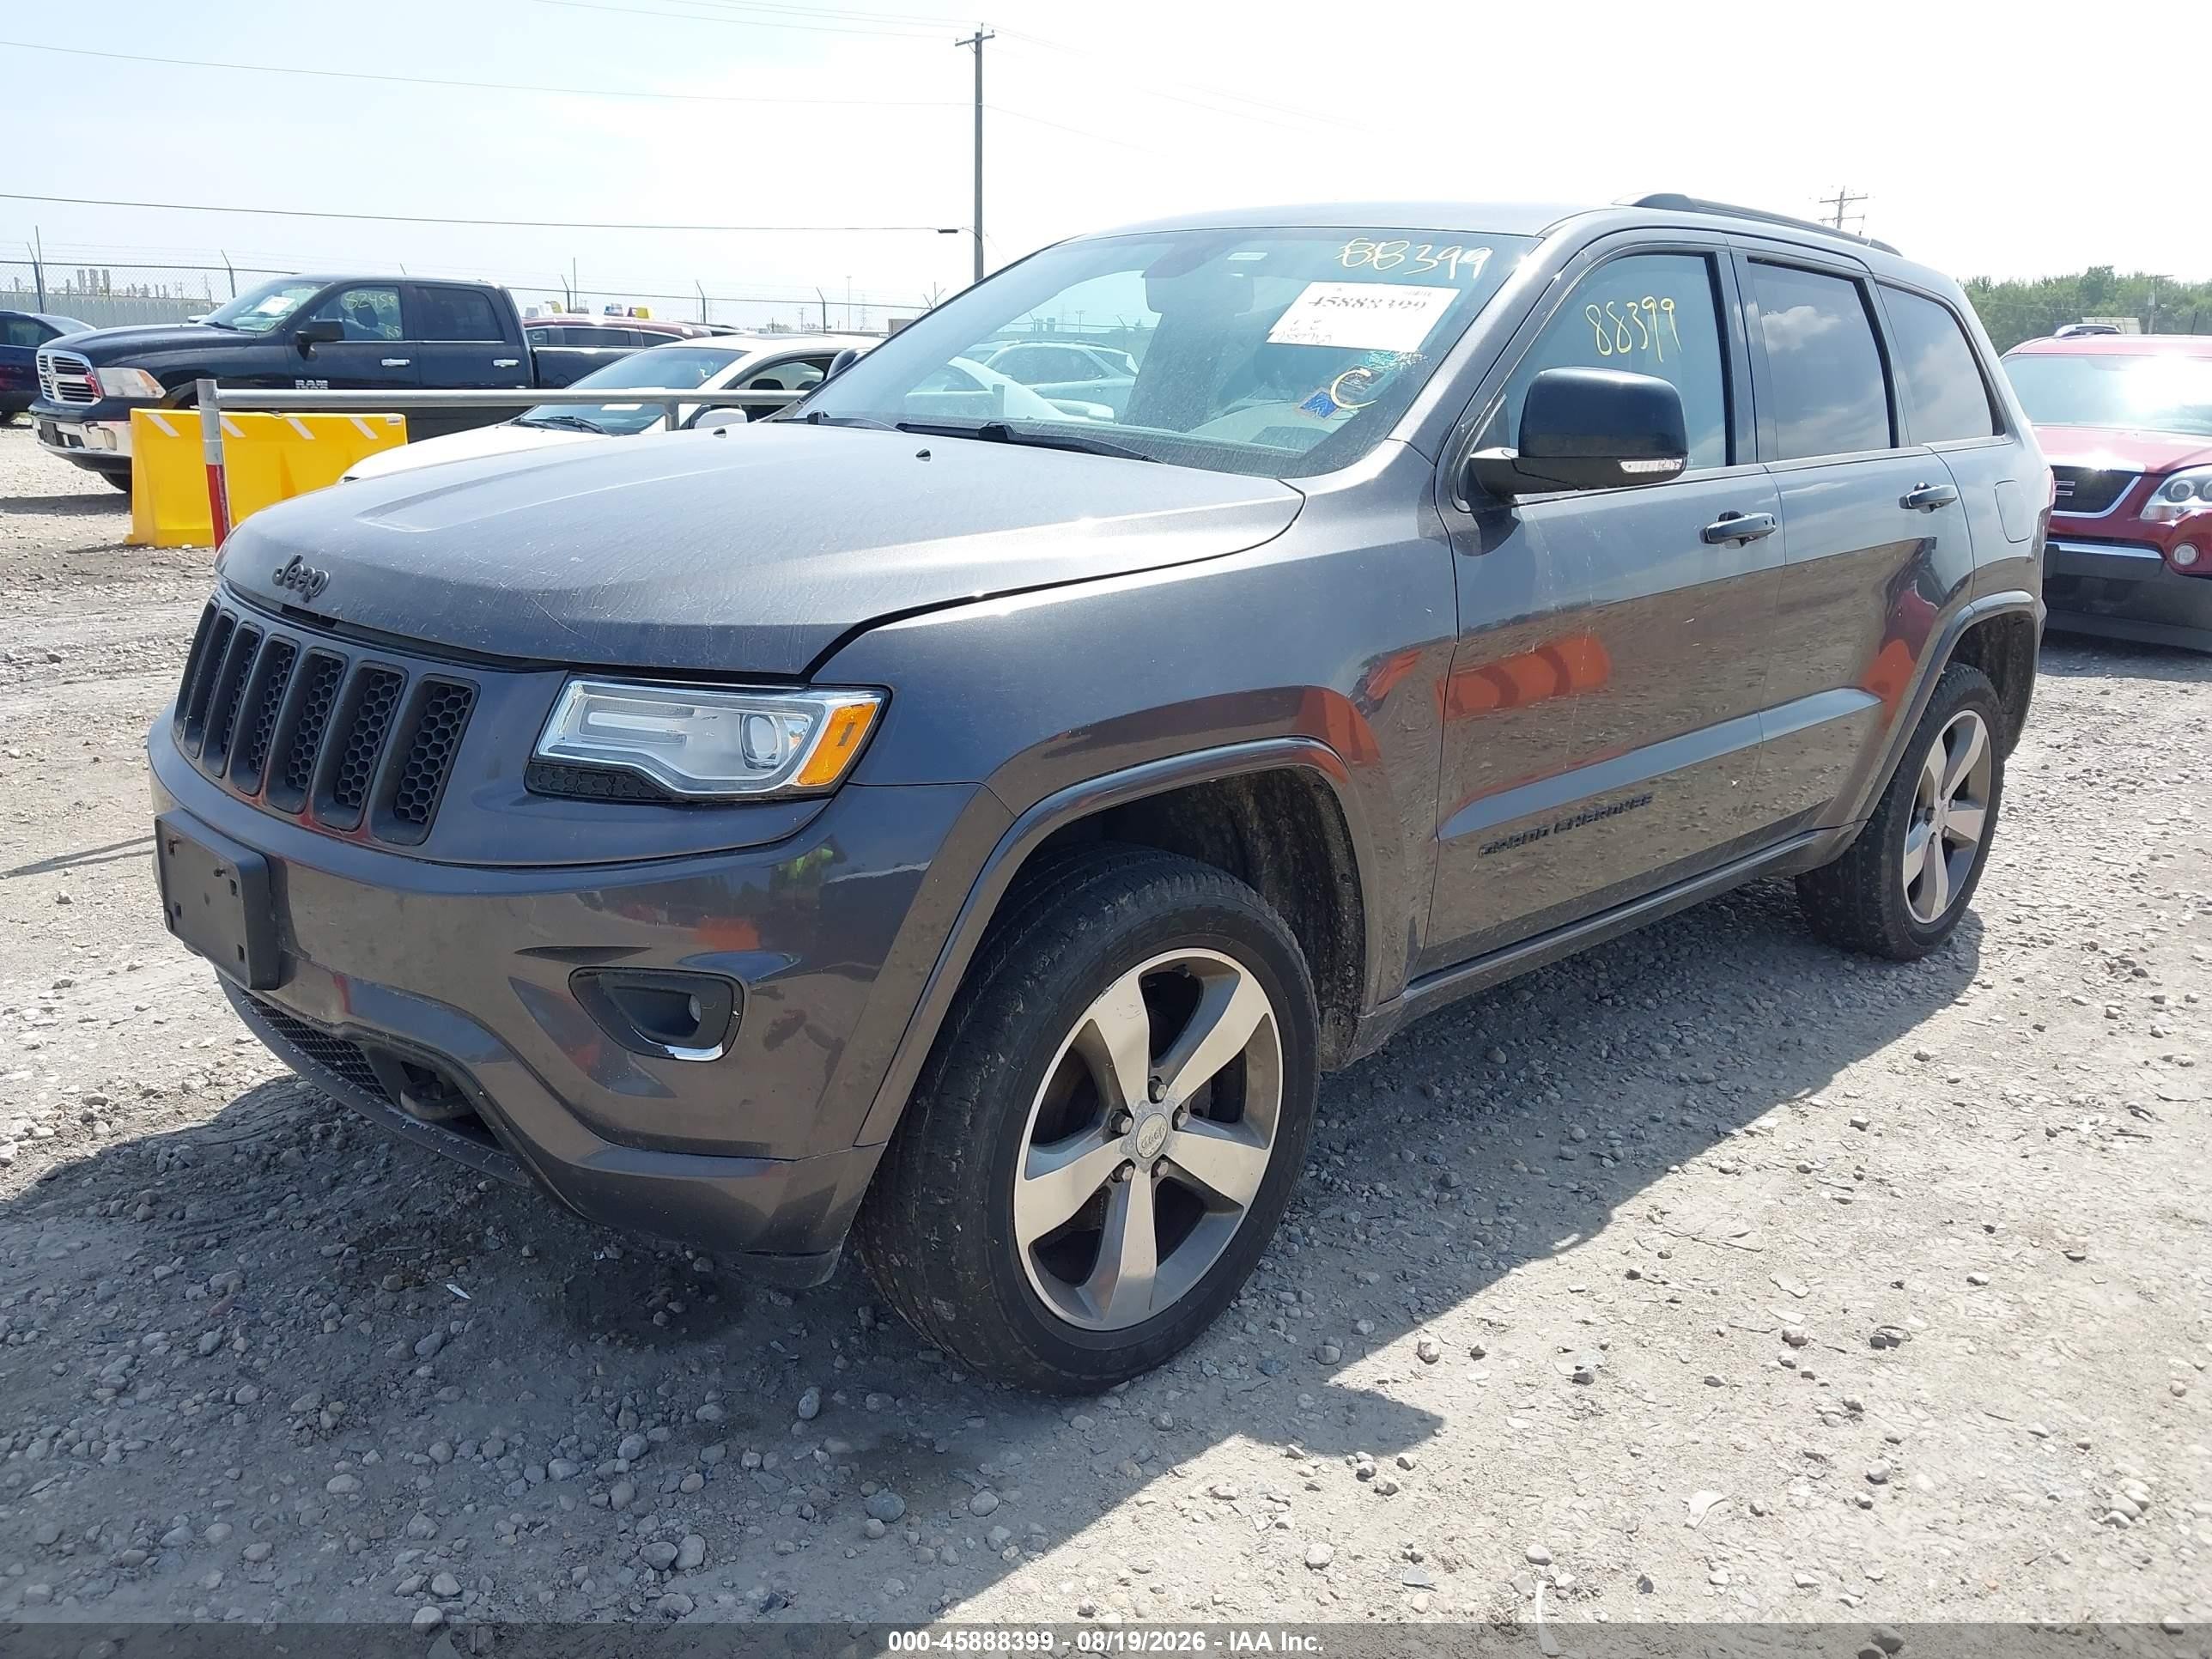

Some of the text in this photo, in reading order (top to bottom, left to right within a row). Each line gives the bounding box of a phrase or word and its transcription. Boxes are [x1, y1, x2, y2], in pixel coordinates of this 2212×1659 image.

[1334, 237, 1493, 280] 88399
[1585, 296, 1682, 362] 88399
[1331, 368, 1378, 410] C
[272, 554, 330, 604] Jeep
